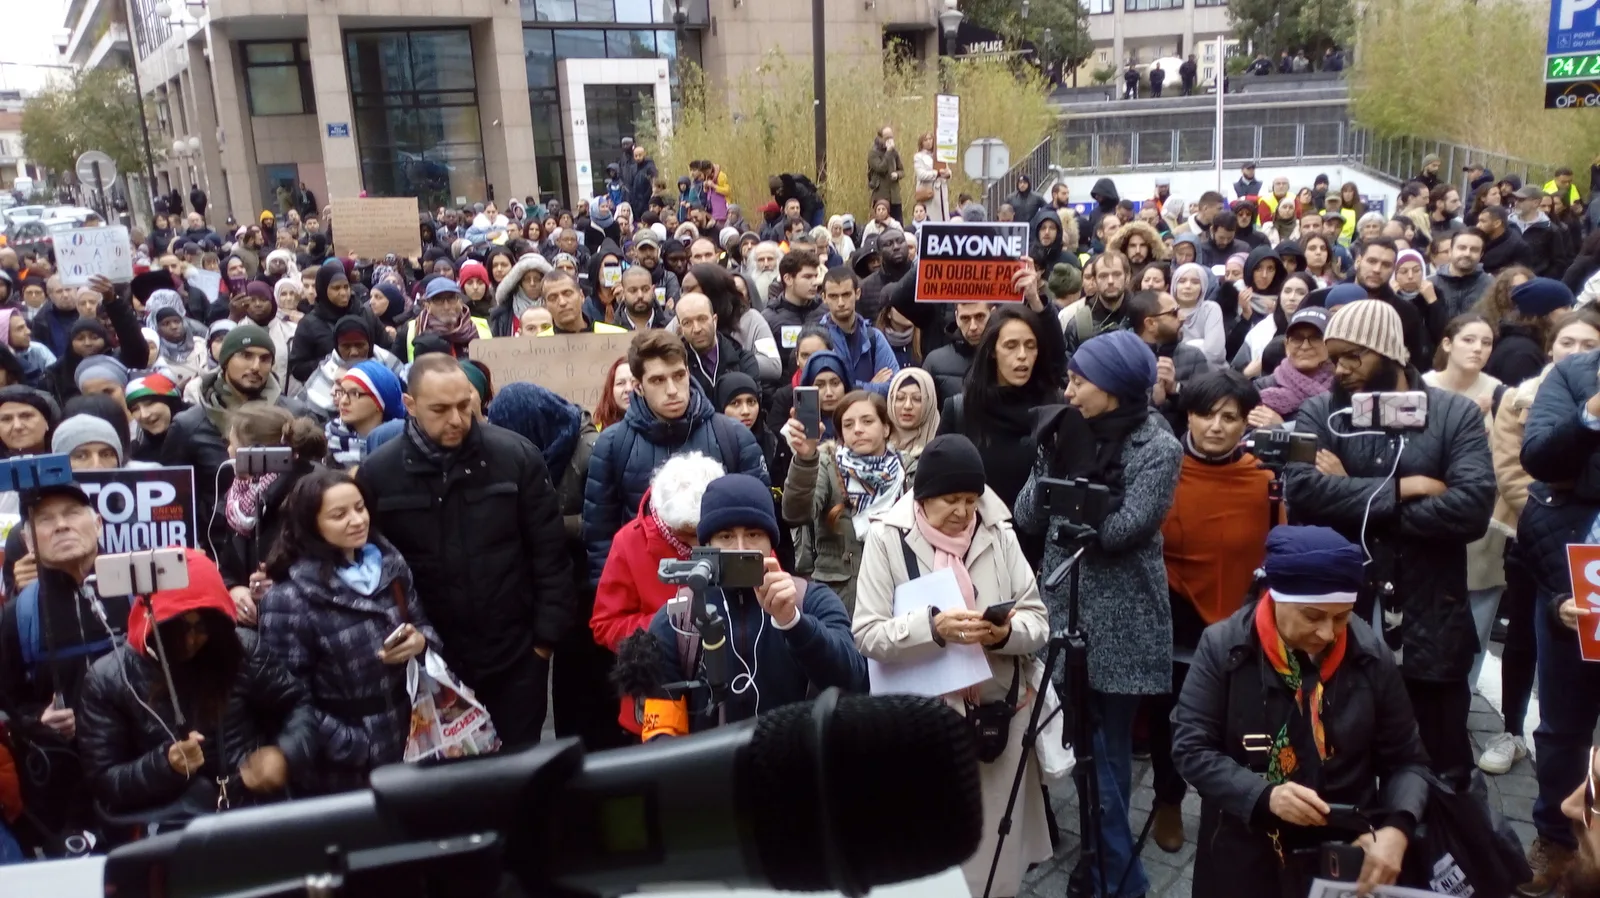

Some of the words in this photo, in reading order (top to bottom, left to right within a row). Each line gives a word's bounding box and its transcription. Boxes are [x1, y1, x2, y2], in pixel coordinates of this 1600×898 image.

[980, 40, 1003, 53] PLACE
[927, 234, 1022, 257] BAYONNE
[924, 263, 943, 279] ON
[946, 264, 993, 280] OUBLIE
[923, 282, 938, 295] ON
[940, 282, 995, 296] PARDONNE
[998, 283, 1021, 296] PA
[476, 346, 498, 359] Un
[511, 337, 590, 357] admirateur
[600, 338, 617, 350] de
